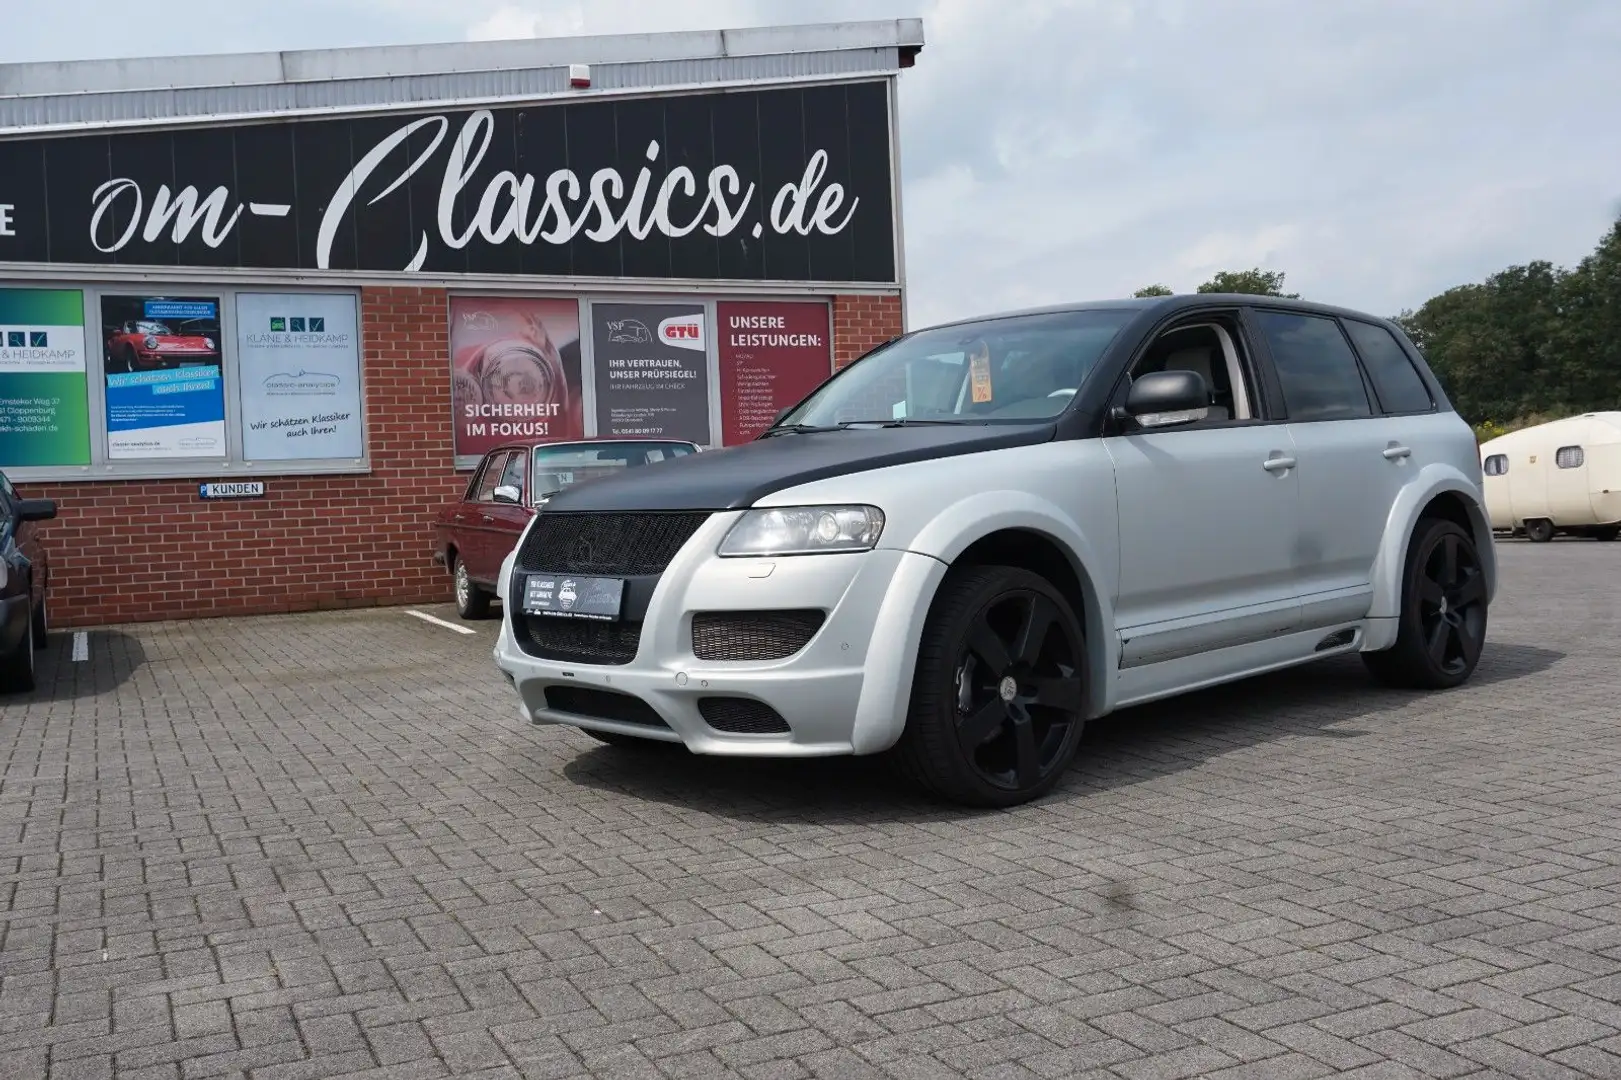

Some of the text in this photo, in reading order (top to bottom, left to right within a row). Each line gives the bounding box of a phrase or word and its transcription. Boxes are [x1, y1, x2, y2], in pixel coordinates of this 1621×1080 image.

[607, 321, 625, 331] VSP
[729, 316, 785, 329] UNSERE
[664, 323, 700, 339] GTÜ
[295, 333, 349, 343] HEIDKAMP
[731, 334, 821, 347] LEISTUNGEN:
[13, 349, 76, 359] HEIDKAMP
[609, 359, 682, 368] IHR VERTRAUEN,
[609, 369, 697, 379] UNSER PRÜFSIEGEL!
[7, 406, 56, 416] Cloppenburg
[465, 403, 560, 417] SICHERHEIT
[250, 421, 267, 430] Wir
[312, 411, 351, 423] Klassiker
[286, 425, 337, 438] auch Ihren!
[466, 422, 549, 436] IM FOKUS!
[212, 483, 259, 494] KUNDEN
